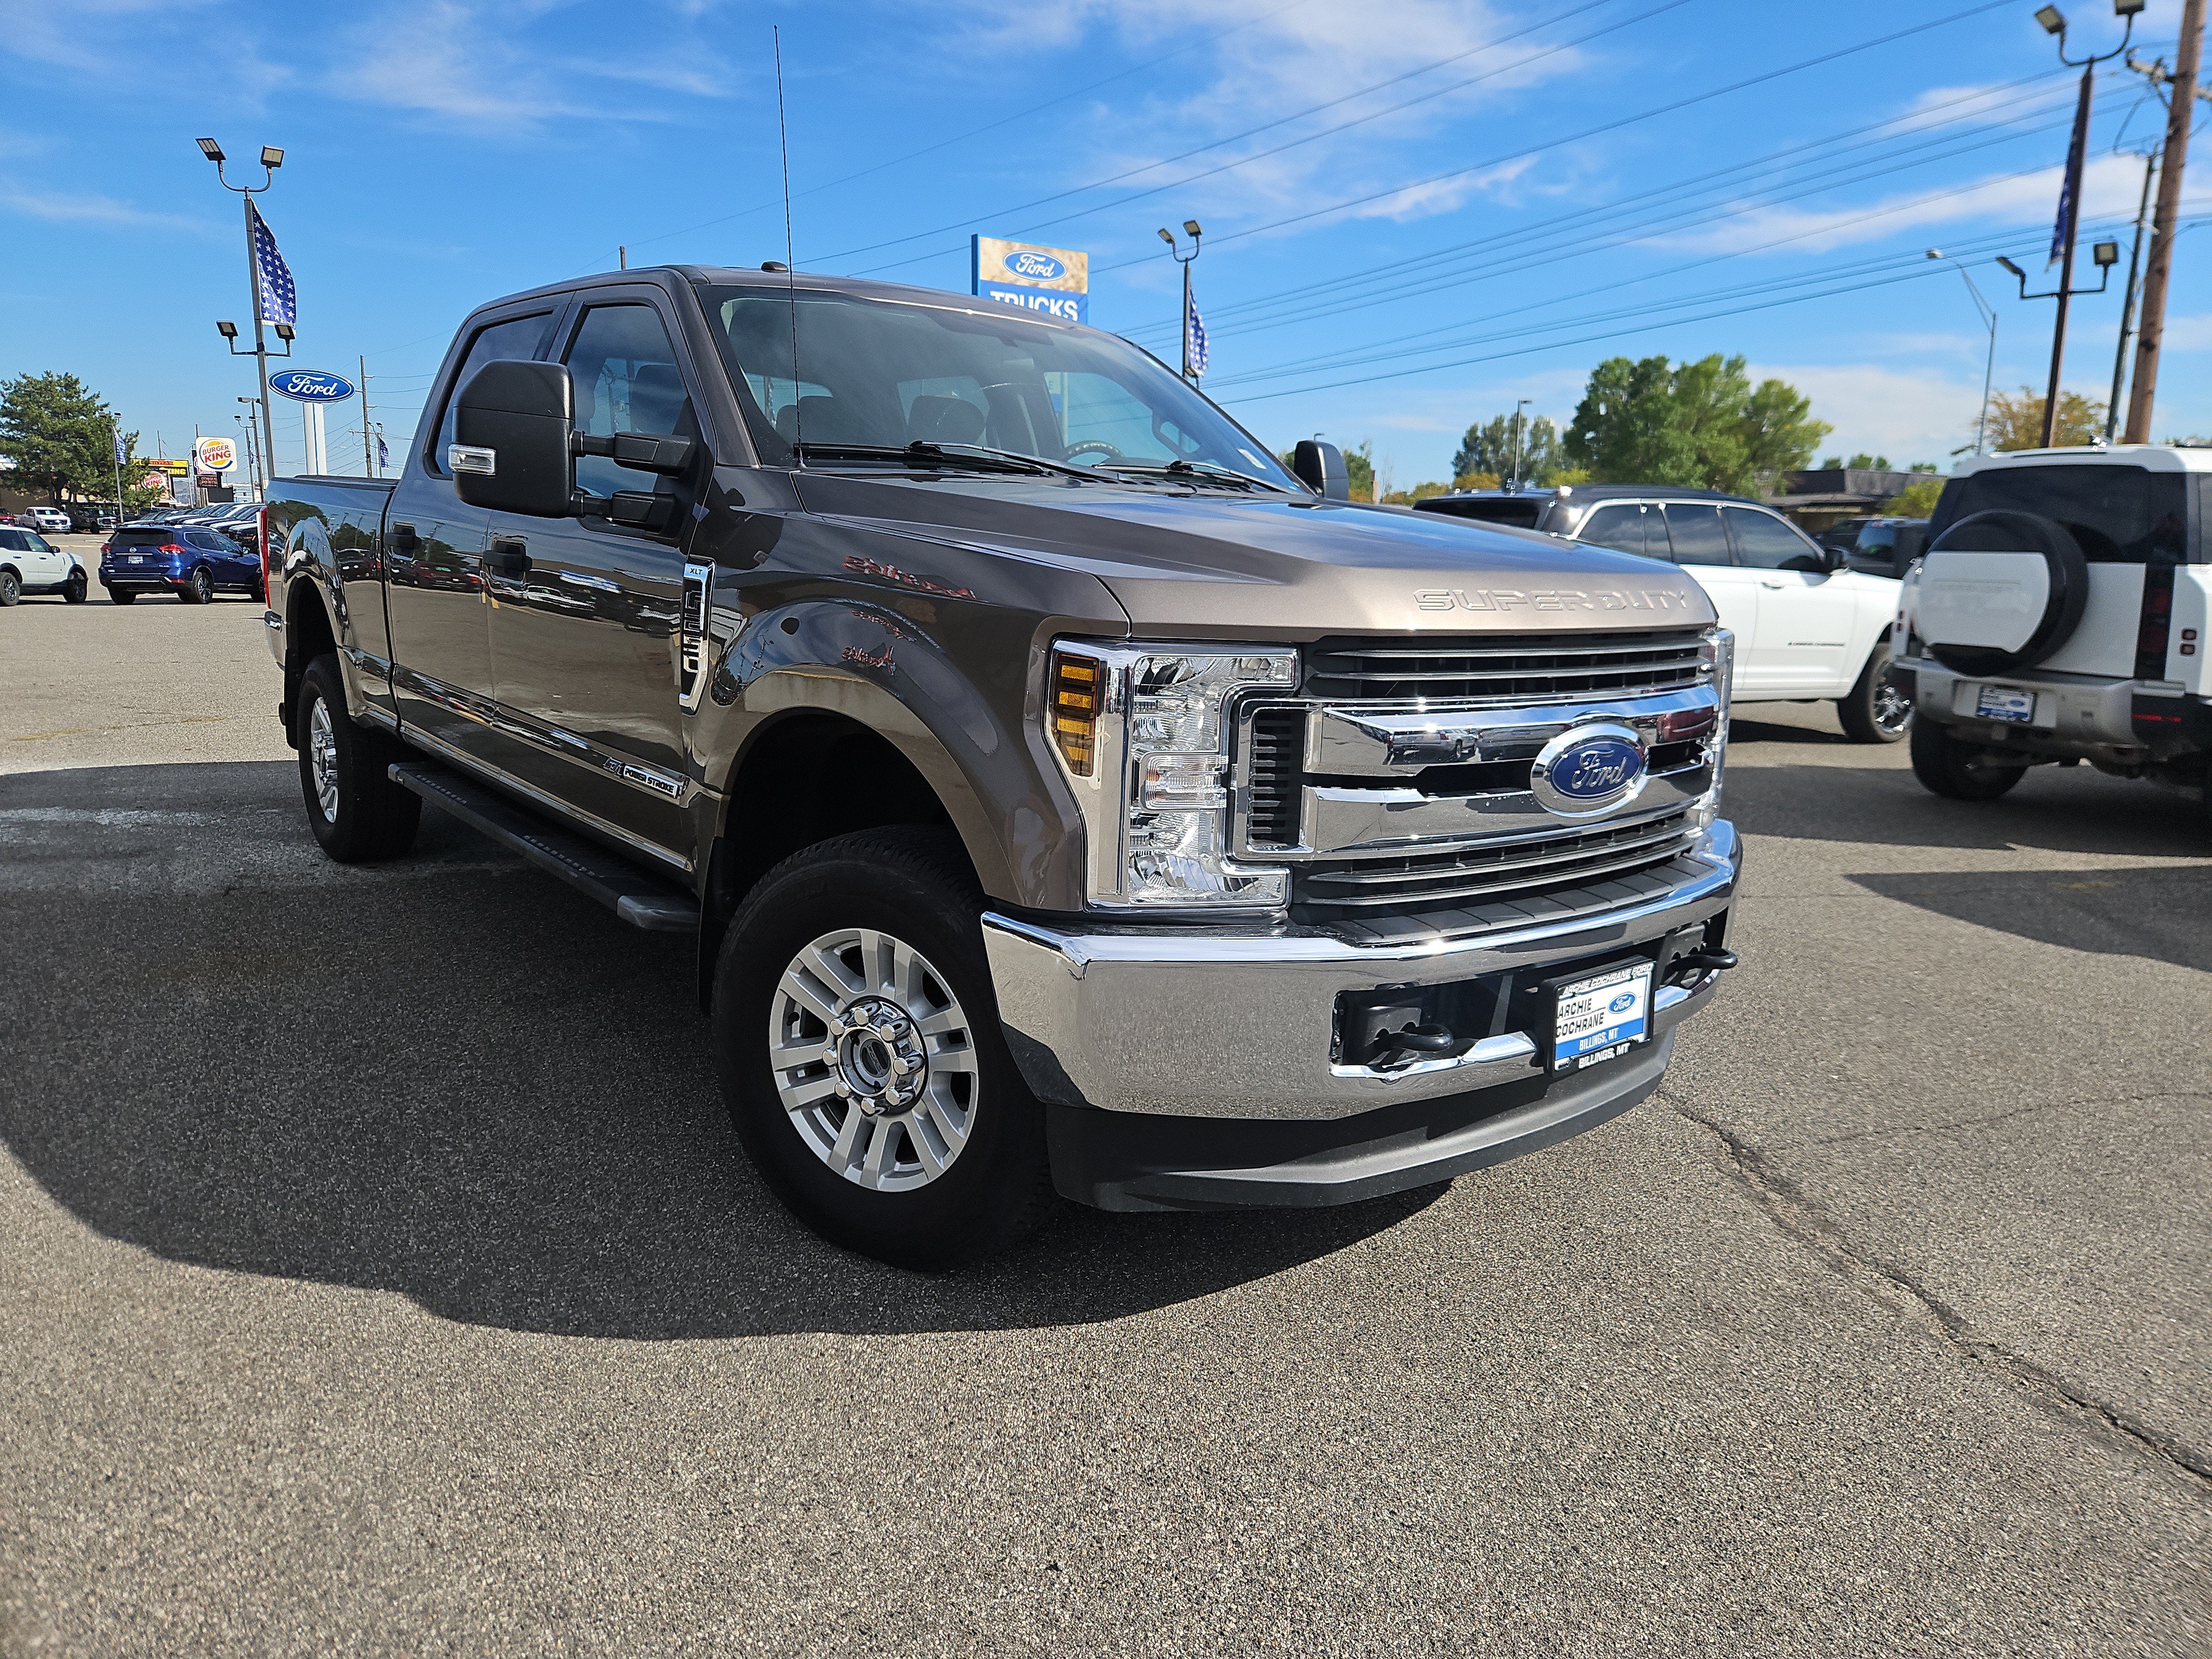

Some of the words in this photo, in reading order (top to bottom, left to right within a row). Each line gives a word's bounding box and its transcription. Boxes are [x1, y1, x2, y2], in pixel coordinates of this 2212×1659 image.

[1015, 254, 1055, 278] Ford
[287, 375, 338, 396] Ford
[202, 445, 229, 455] BURGER
[204, 451, 232, 463] KING
[146, 478, 163, 486] KING
[689, 567, 703, 575] XLT
[1413, 588, 1594, 612] SUPER
[1593, 590, 1687, 610] DUTY
[1571, 748, 1628, 789] Ford
[625, 768, 647, 783] POWER
[647, 777, 674, 793] STROKE
[1562, 980, 1591, 995] ARCHIE
[1590, 968, 1631, 987] COCHRANE
[1631, 963, 1652, 975] FORD
[1557, 998, 1592, 1019] ARCHIE
[1613, 995, 1631, 1011] Ford
[1557, 1012, 1605, 1038] COCHRANE
[1579, 1031, 1607, 1051] BILLINGS,
[1608, 1027, 1619, 1040] MT
[1616, 1042, 1631, 1056] MT
